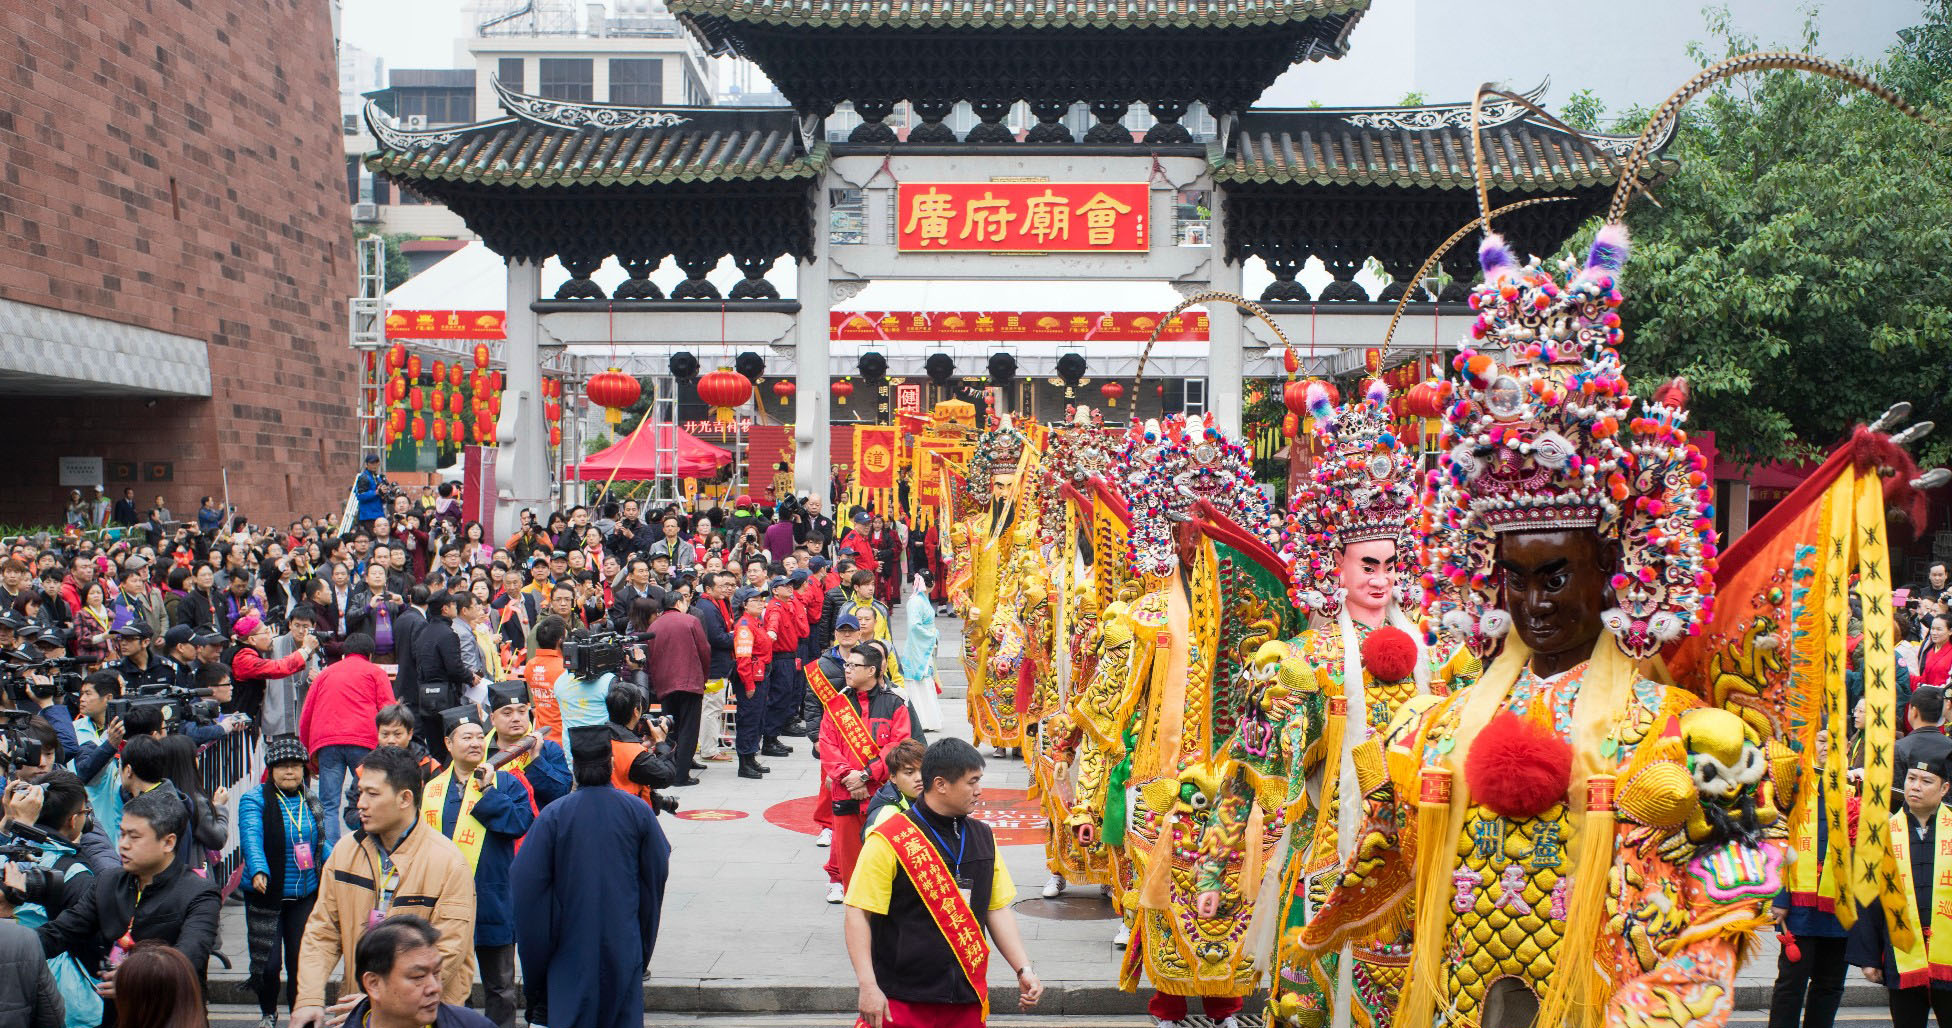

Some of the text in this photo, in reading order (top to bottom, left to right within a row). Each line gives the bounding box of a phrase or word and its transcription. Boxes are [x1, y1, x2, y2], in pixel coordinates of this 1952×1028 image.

[904, 187, 1132, 246] 廣府廟會
[867, 448, 885, 468] 道
[903, 837, 933, 869] 蘆洲
